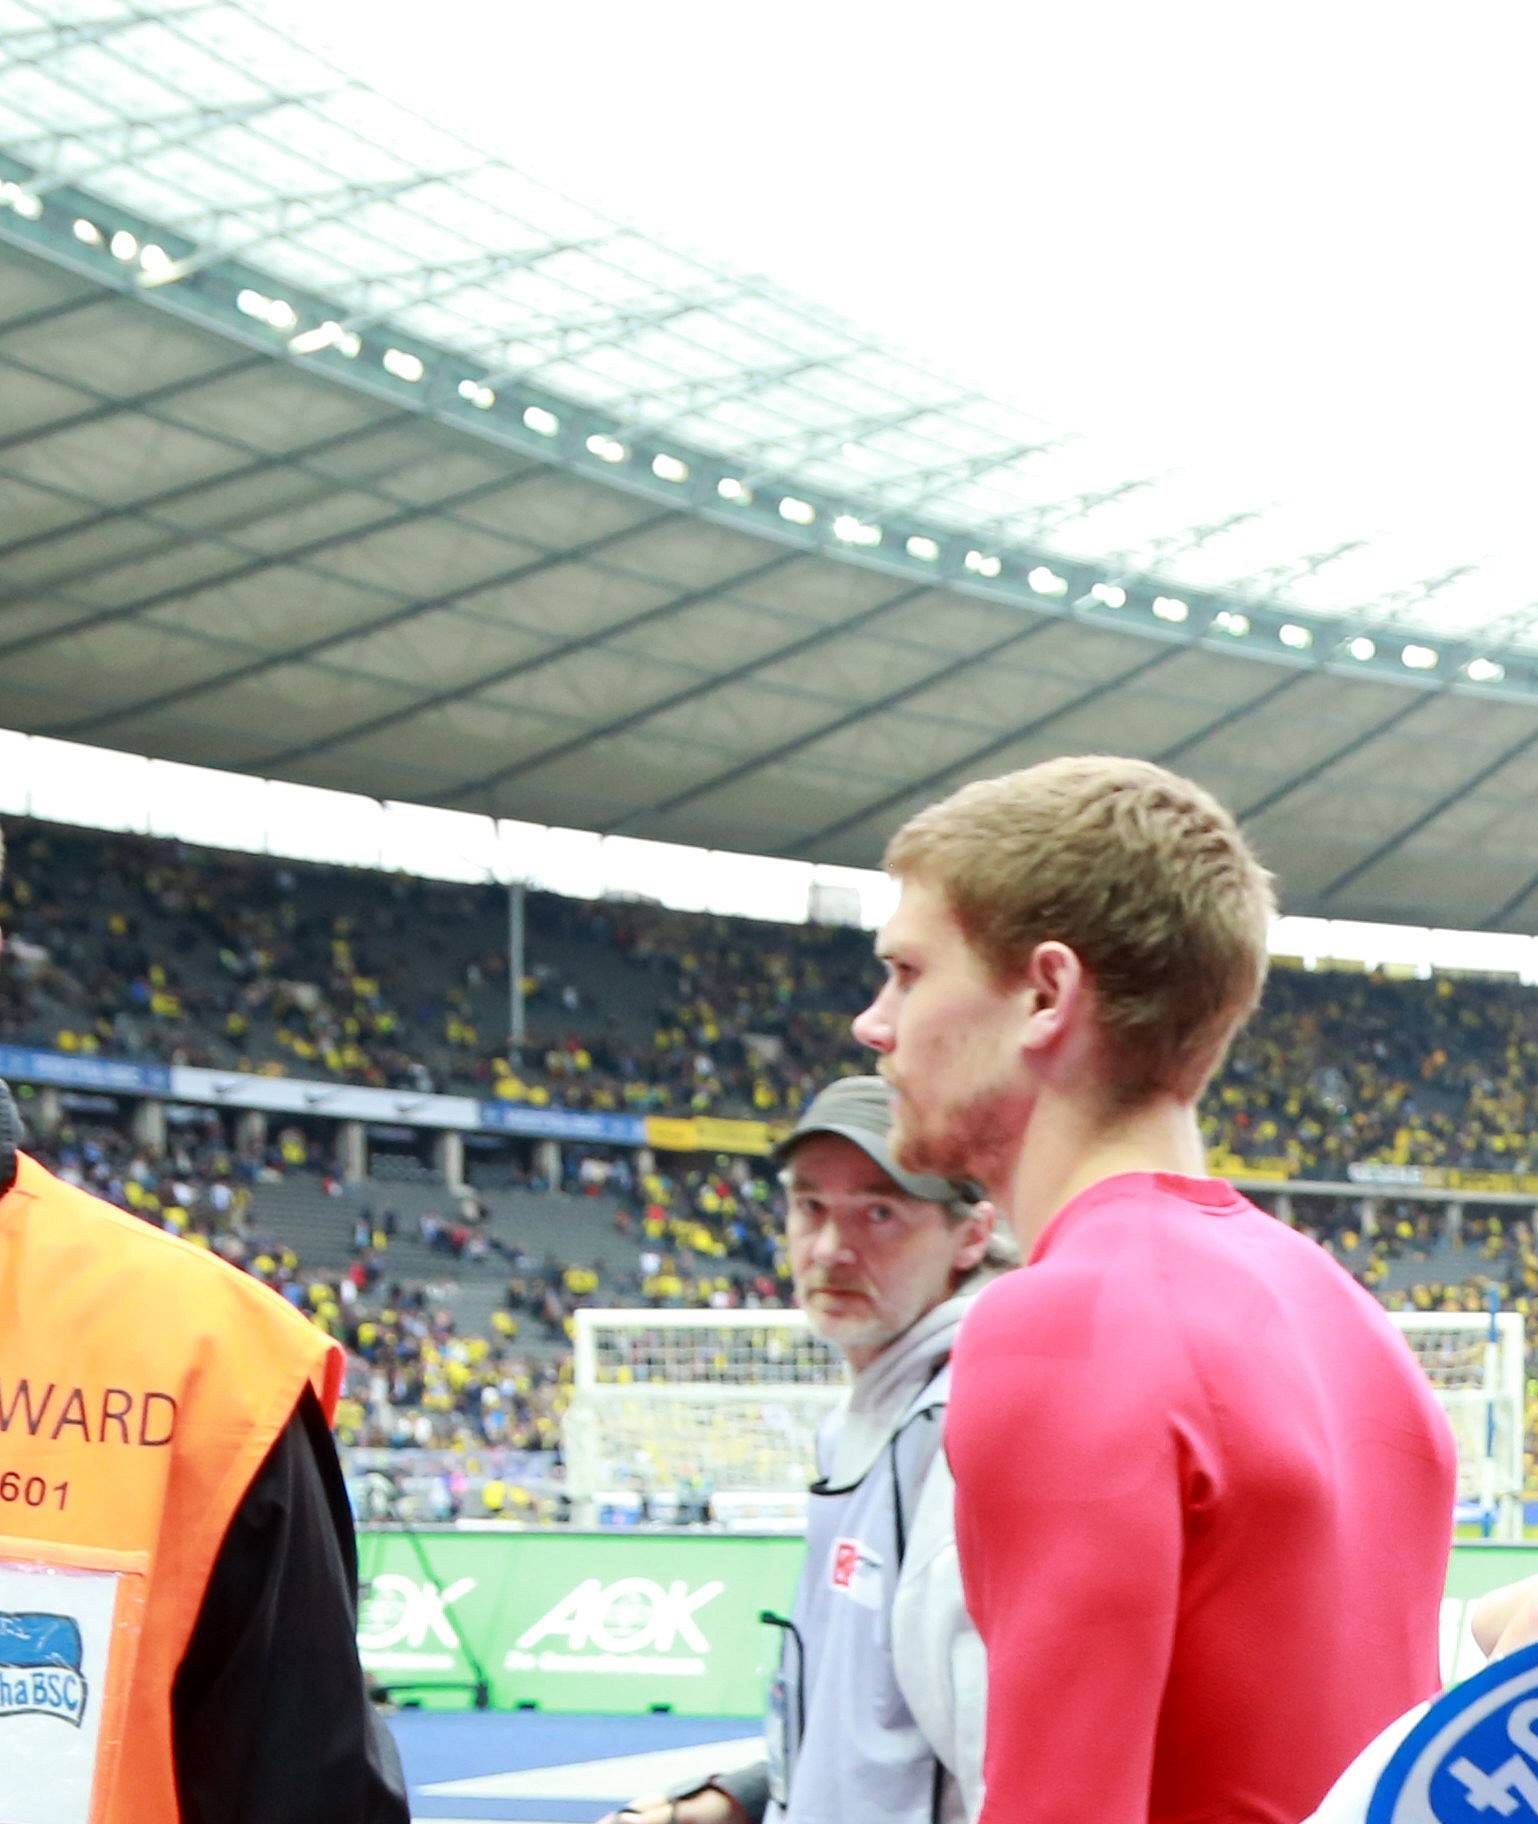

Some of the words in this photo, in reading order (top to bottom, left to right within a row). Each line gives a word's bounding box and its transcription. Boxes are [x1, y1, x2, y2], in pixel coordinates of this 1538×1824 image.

[0, 1379, 177, 1446] WARD
[0, 1471, 68, 1511] 601
[514, 1576, 725, 1653] AOK
